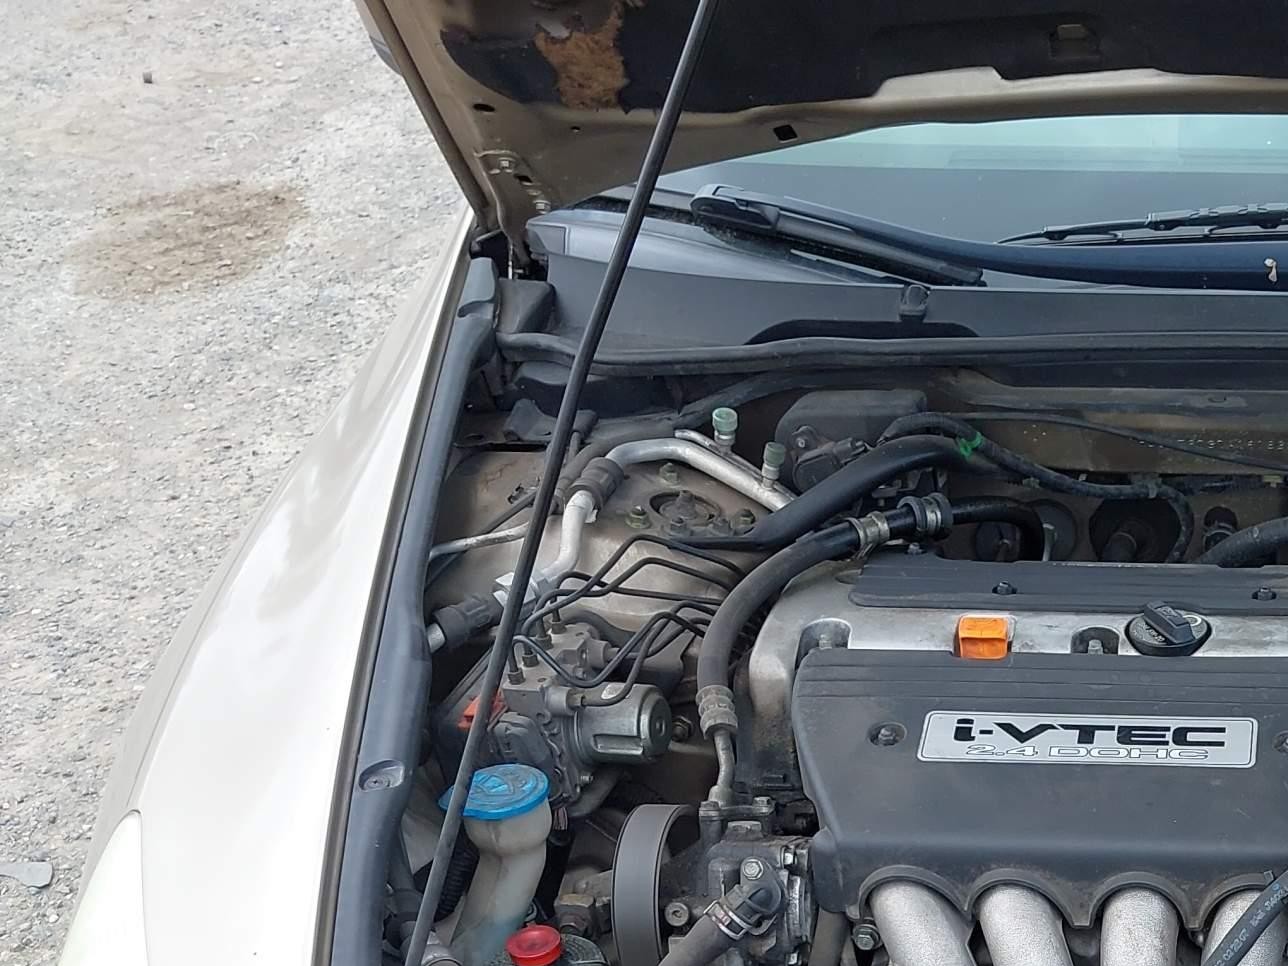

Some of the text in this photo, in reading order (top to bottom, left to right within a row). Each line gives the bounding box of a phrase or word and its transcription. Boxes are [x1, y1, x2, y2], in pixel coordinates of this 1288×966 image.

[953, 718, 1226, 747] i-VTEC
[966, 744, 1210, 760] 2.4 DOHC
